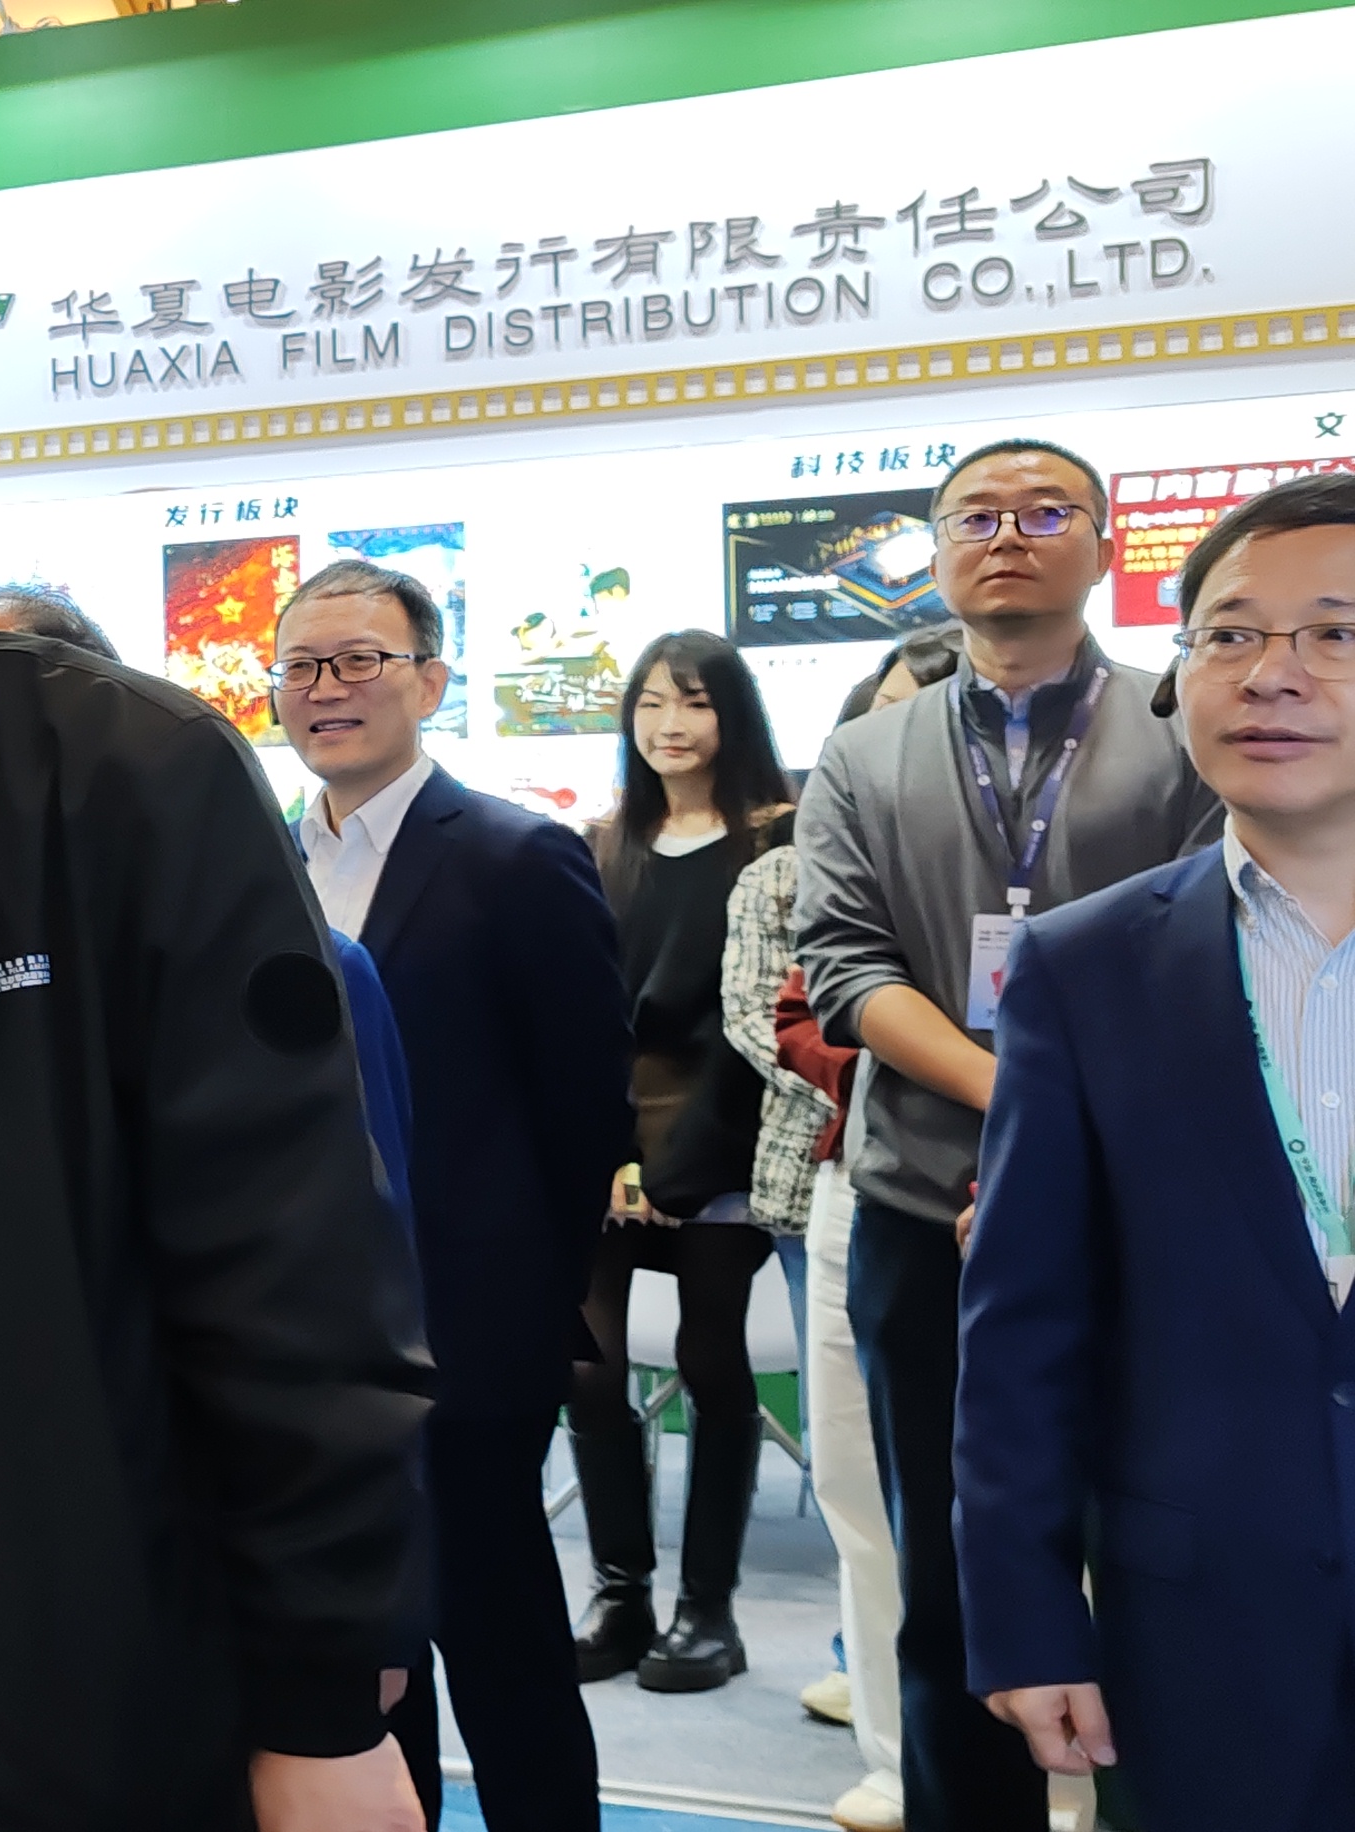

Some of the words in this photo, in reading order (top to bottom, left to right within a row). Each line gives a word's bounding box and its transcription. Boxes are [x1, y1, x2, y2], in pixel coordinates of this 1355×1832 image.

[48, 158, 1213, 346] 华夏电影发行有限责任公司
[50, 341, 241, 397] HUAXIA
[280, 322, 401, 370] FILM
[444, 271, 873, 358] DISTRIBUTION
[791, 443, 956, 478] 科技板块
[165, 497, 298, 527] 发行板块
